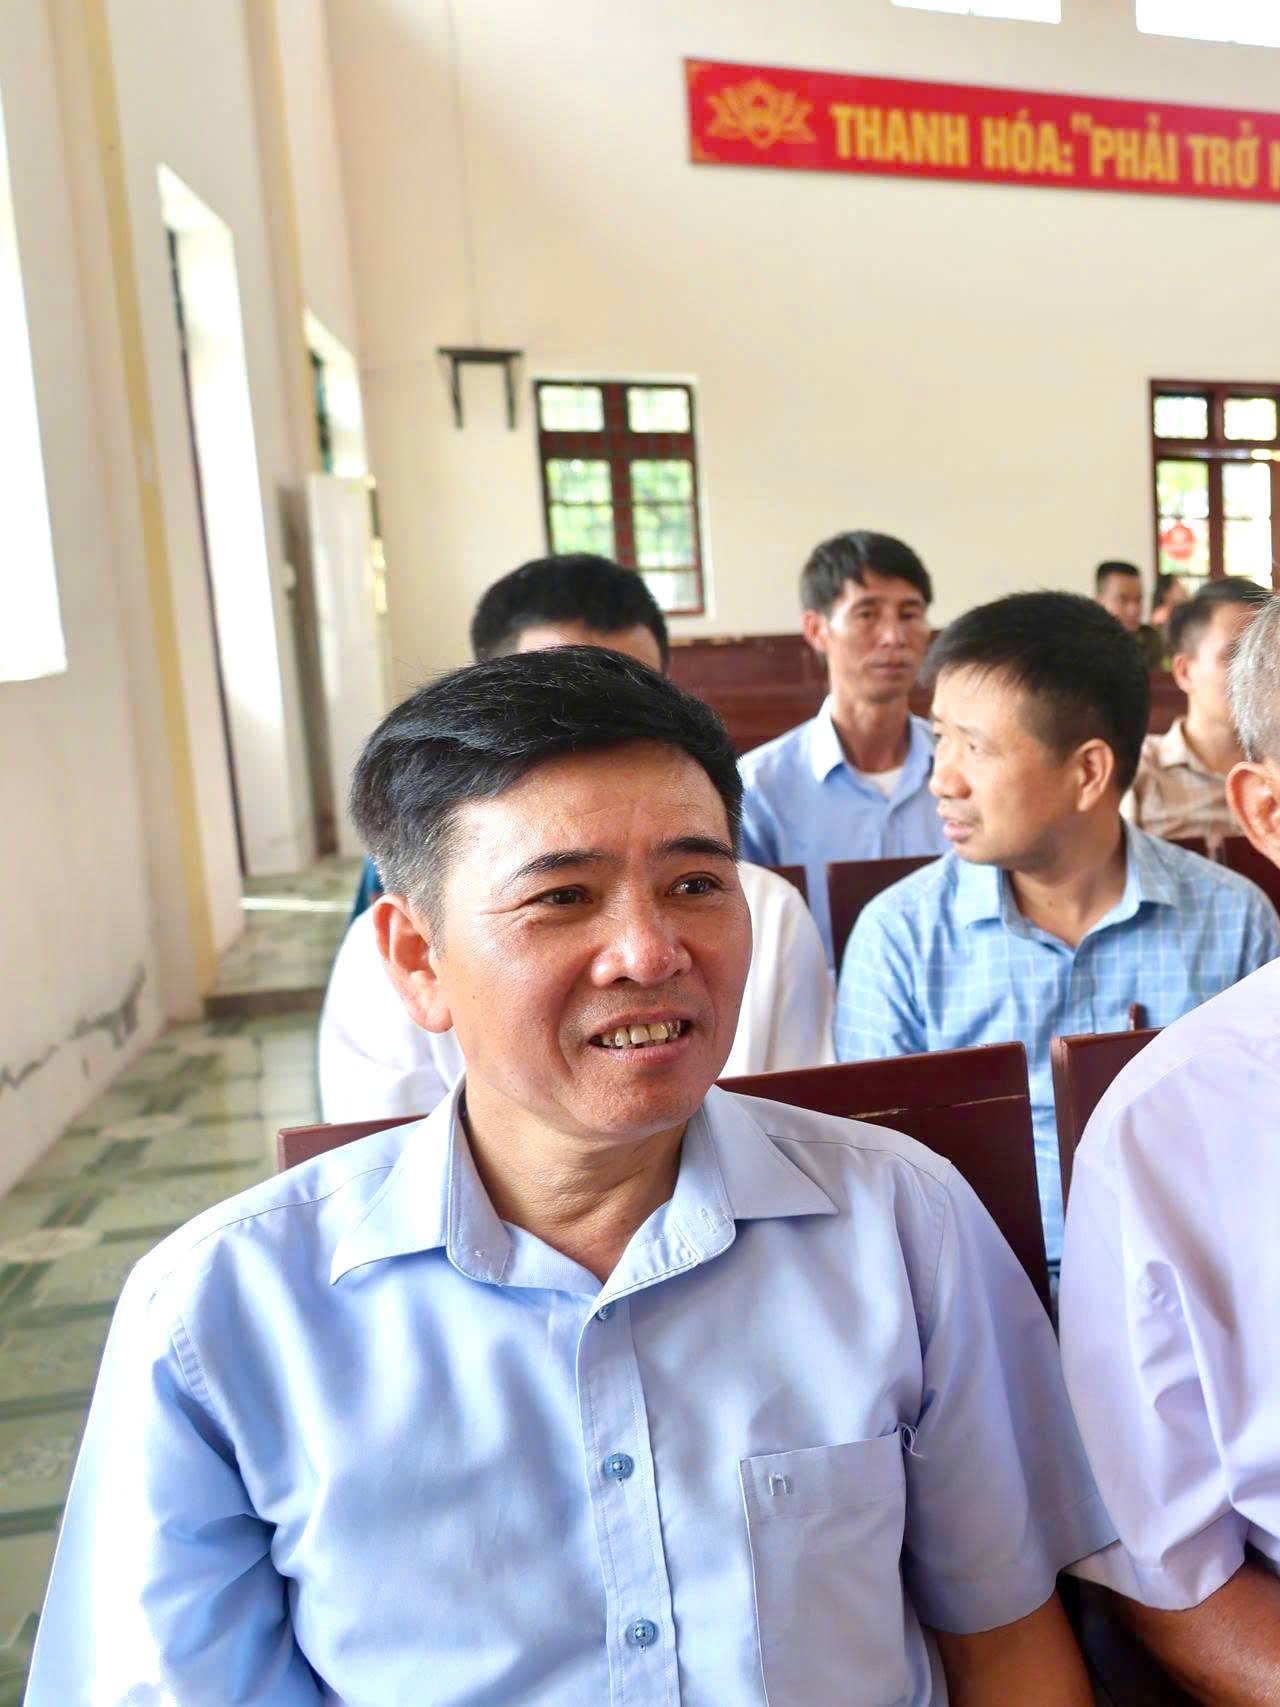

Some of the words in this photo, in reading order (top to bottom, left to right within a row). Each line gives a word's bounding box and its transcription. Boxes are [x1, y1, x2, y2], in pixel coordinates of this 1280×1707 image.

[829, 104, 968, 168] THANH
[981, 108, 1073, 175] HÓA:
[1188, 120, 1260, 187] TRỞ
